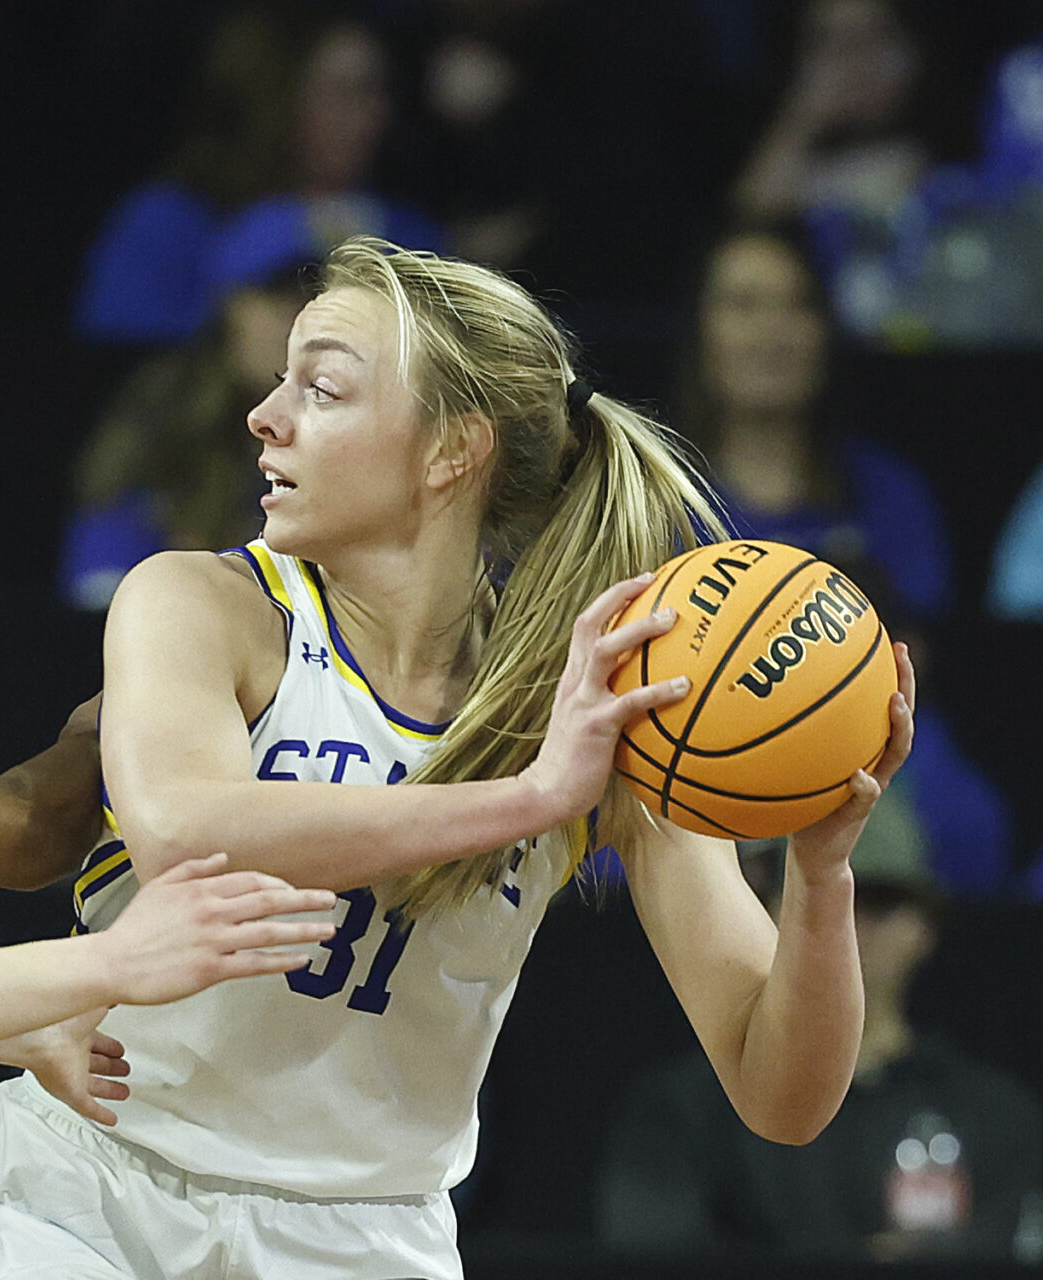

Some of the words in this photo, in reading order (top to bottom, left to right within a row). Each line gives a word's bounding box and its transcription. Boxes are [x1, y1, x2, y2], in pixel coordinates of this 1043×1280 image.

[689, 615, 713, 657] NXT
[735, 571, 870, 699] Wilson
[284, 885, 417, 1017] 31
